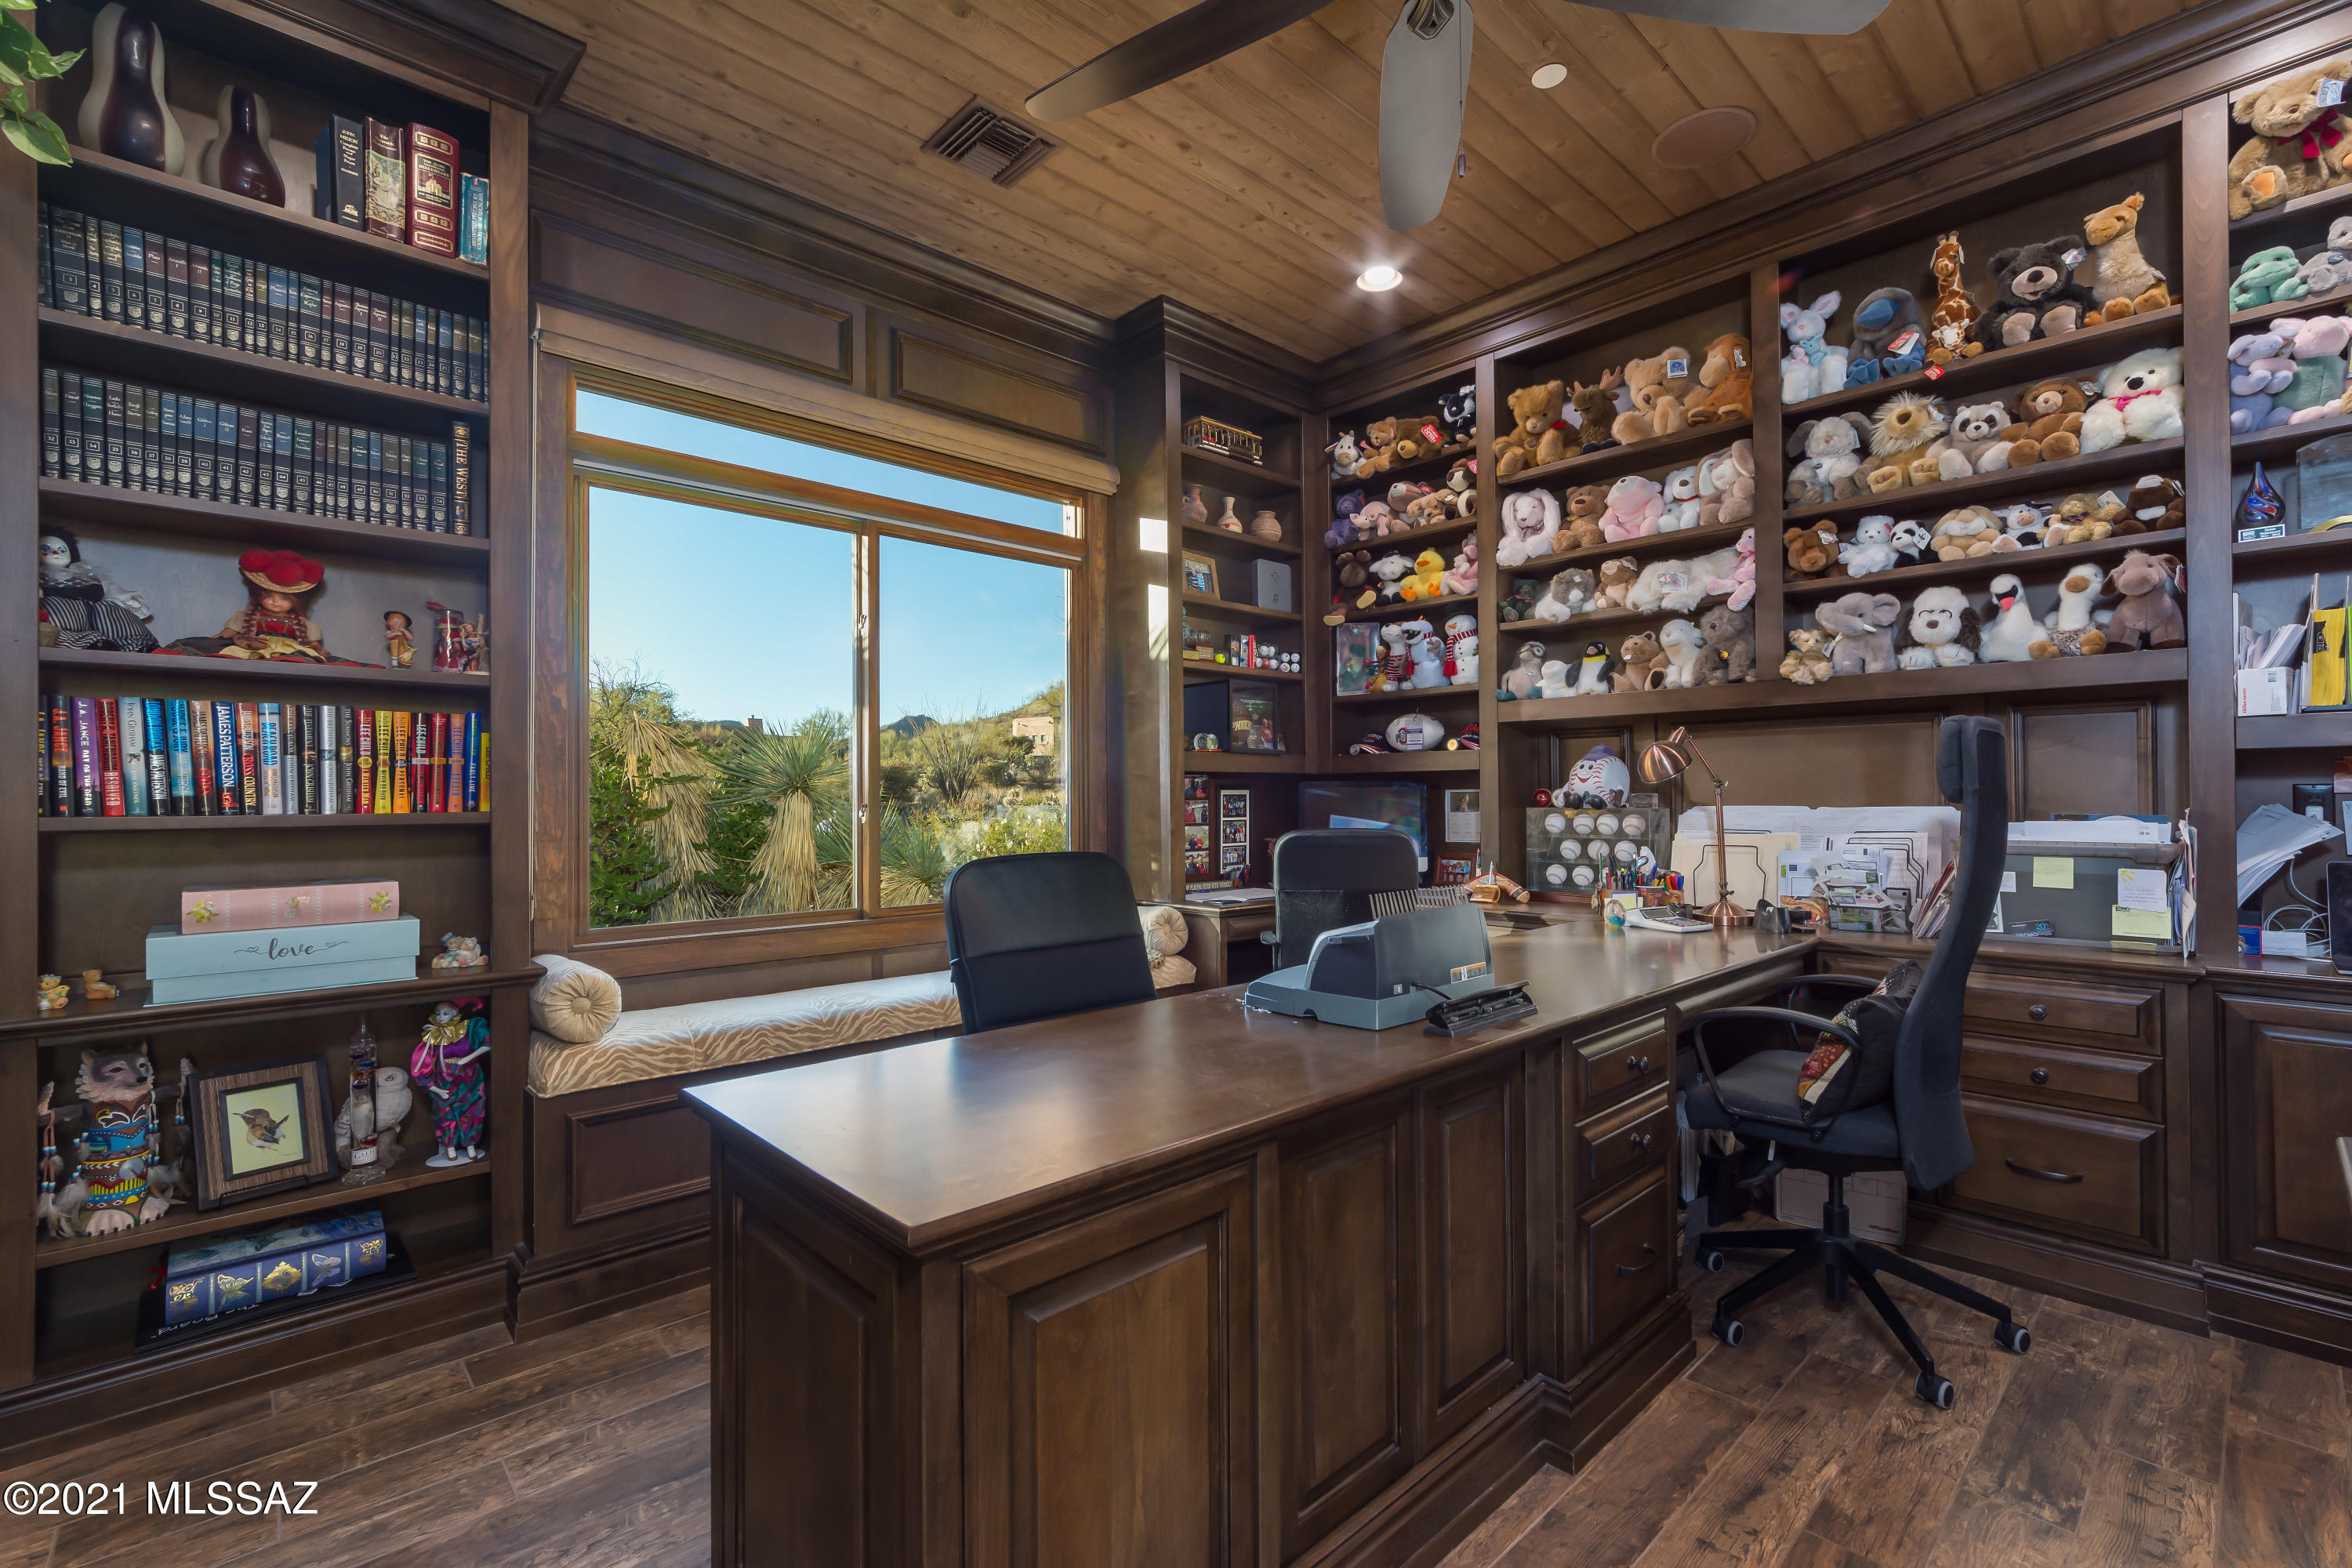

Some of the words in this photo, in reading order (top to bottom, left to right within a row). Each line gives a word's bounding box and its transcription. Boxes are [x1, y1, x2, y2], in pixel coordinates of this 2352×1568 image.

[456, 441, 468, 465] THE
[456, 466, 469, 499] WEST
[53, 709, 67, 724] J.A.
[78, 702, 87, 717] J.A.
[125, 702, 135, 718] JOHN
[145, 701, 162, 728] LONDON
[192, 710, 208, 728] JAMES
[241, 710, 252, 724] JAMES
[216, 706, 231, 735] JAMES
[360, 724, 371, 735] LEE
[379, 725, 389, 735] LEE
[416, 724, 426, 735] LEE
[53, 725, 68, 753] JANCE
[79, 720, 89, 746] JANCE
[127, 720, 137, 747] GRISHAM
[147, 728, 164, 751] BRIDGES
[241, 724, 254, 750] PATTERSON
[262, 723, 278, 746] BEACH
[396, 726, 405, 737] LEE
[173, 735, 188, 753] JURY
[194, 728, 209, 759] PATTERSON
[360, 737, 371, 755] CHILD
[379, 738, 389, 757] CHILD
[396, 739, 405, 757] CHILD
[416, 737, 426, 754] CHILD
[149, 754, 165, 771] JAMES
[220, 735, 235, 787] PATTERSON
[242, 753, 255, 776] CROSS
[263, 746, 278, 766] ROAD
[83, 764, 90, 773] OF
[303, 764, 314, 778] JOHN
[344, 762, 353, 776] JOHN
[104, 771, 121, 806] RESOLVED
[151, 771, 168, 800] PATTERSON
[194, 768, 213, 796] CROSS
[244, 776, 256, 806] COUNTRY
[58, 787, 67, 798] EVIL
[84, 789, 93, 806] DEAD
[268, 938, 314, 960] love
